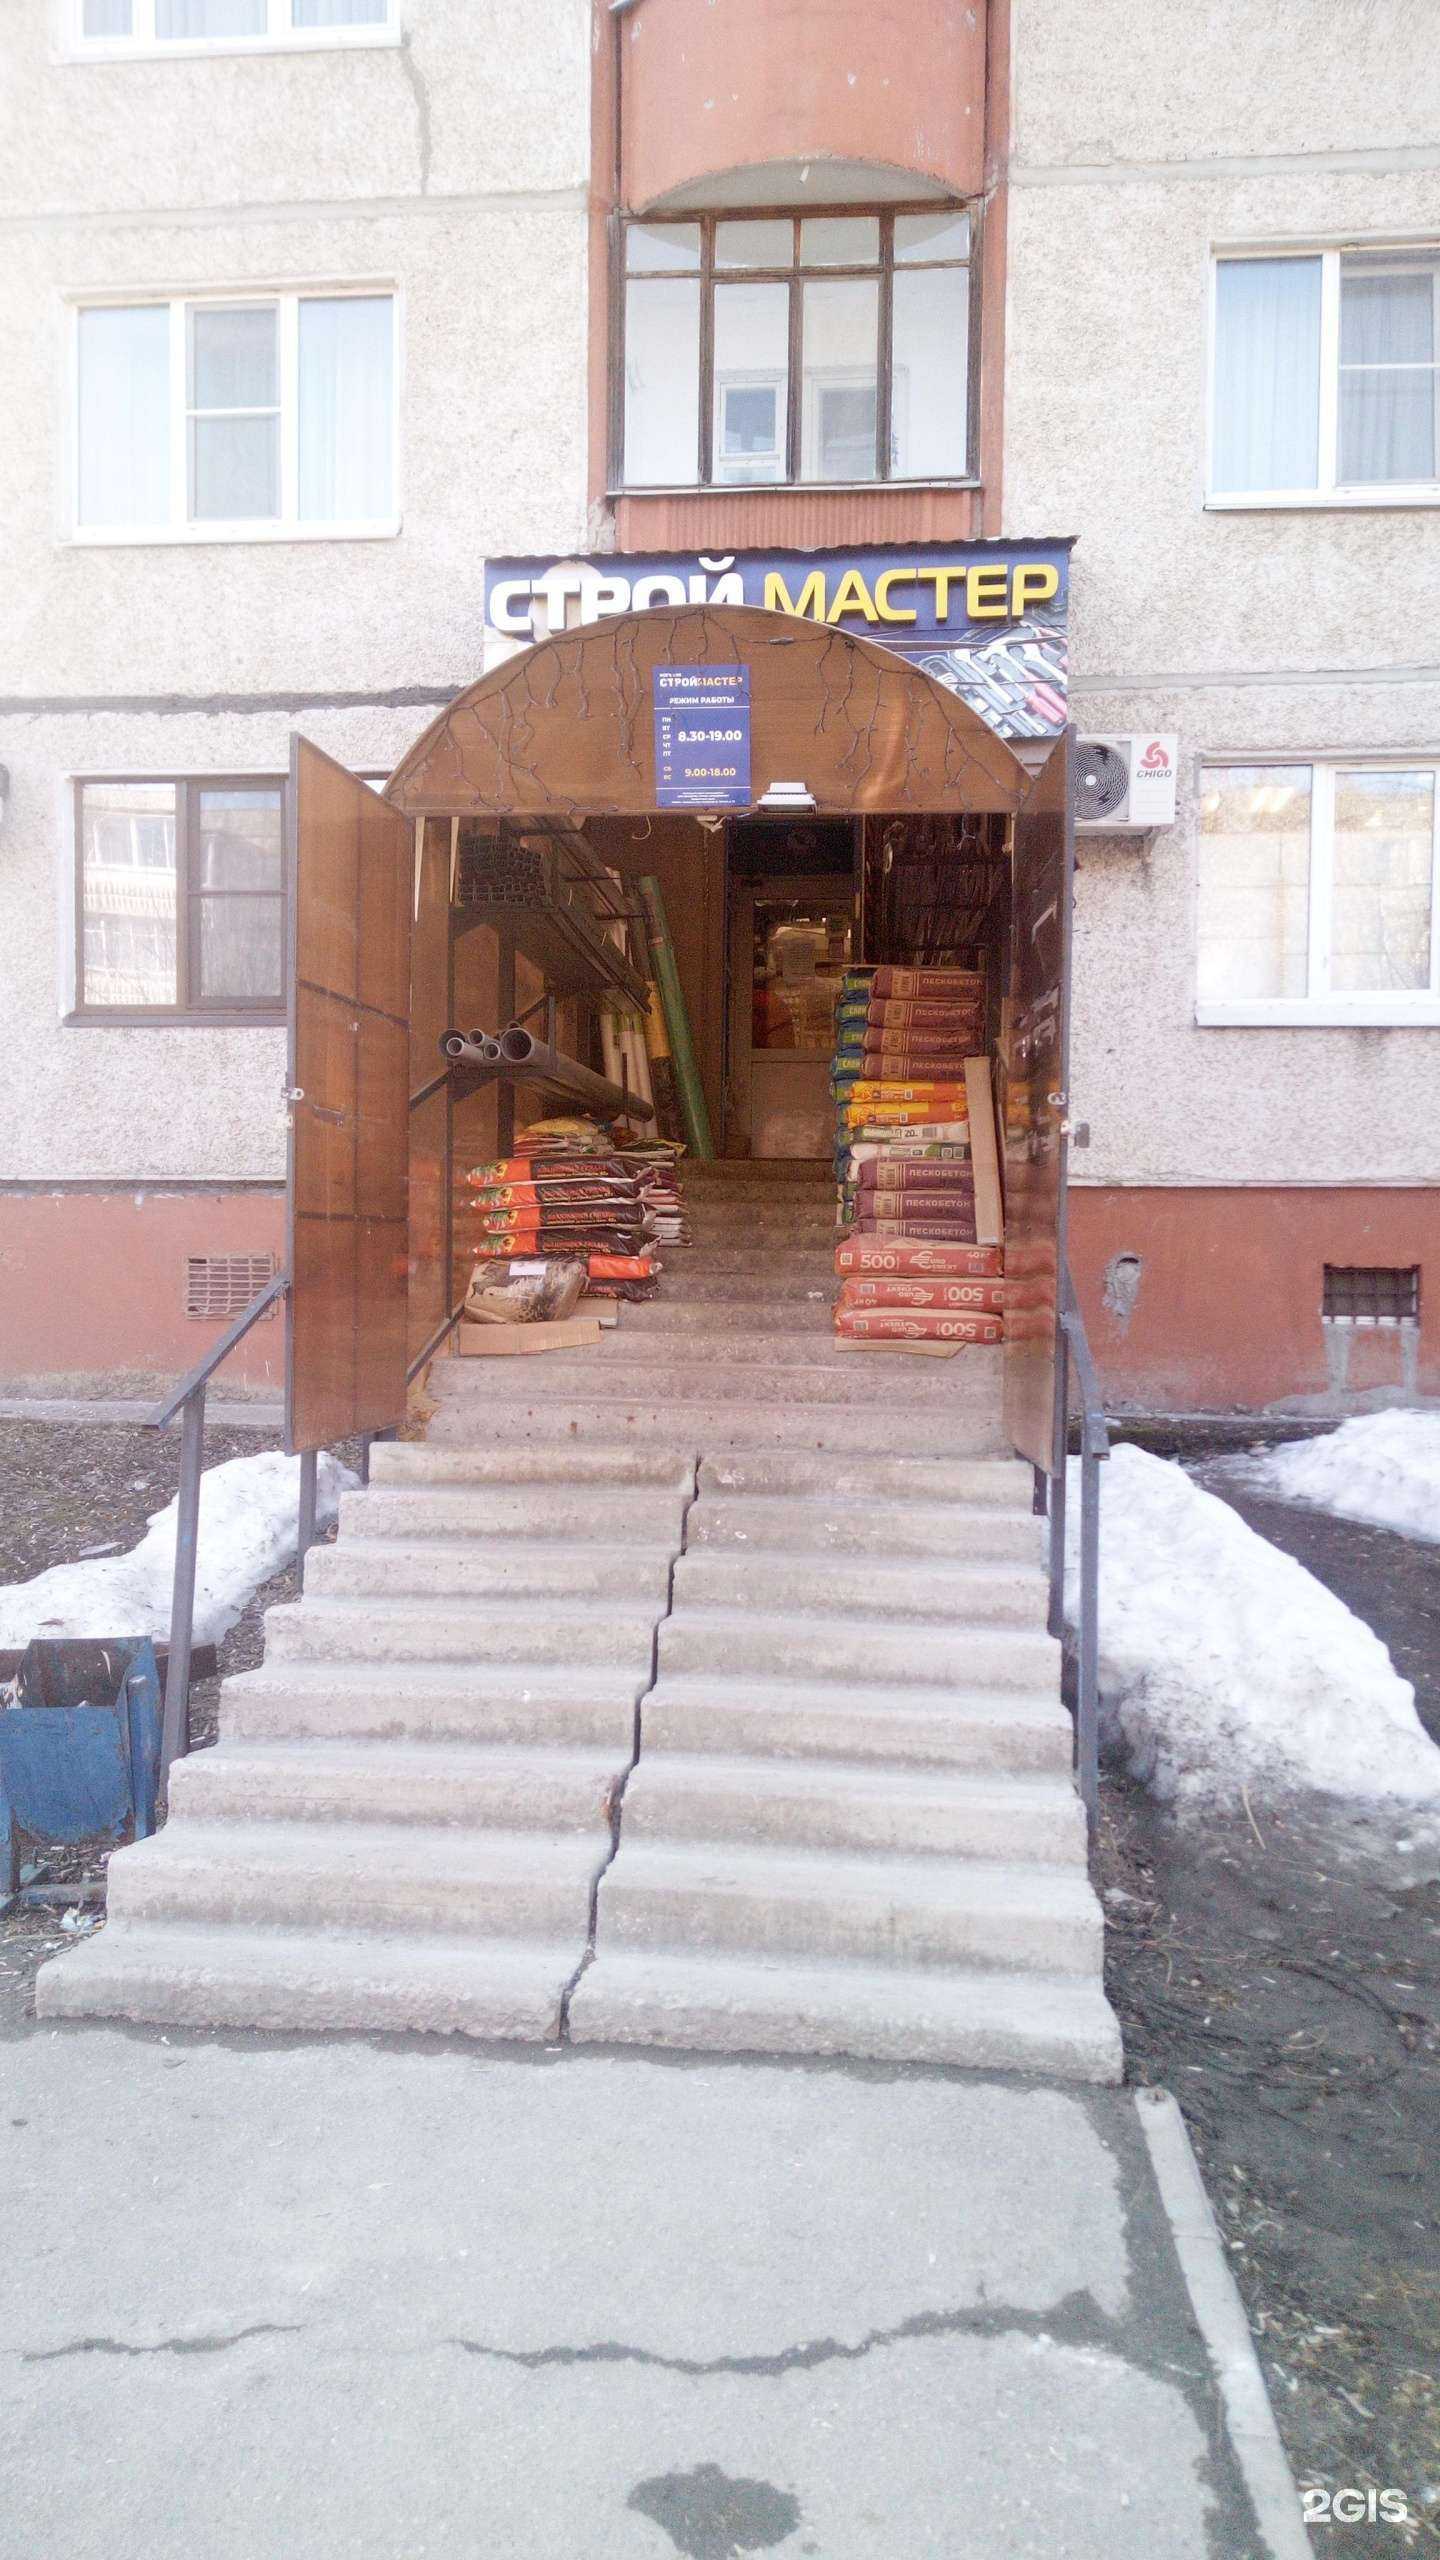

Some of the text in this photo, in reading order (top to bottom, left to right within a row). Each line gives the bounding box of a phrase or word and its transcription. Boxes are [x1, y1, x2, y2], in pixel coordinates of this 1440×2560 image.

[490, 556, 1060, 631] СТРОЙ МАСТЕР
[701, 696, 735, 704] РАБОТЫ
[678, 730, 742, 742] 8.30-19.00
[684, 768, 736, 777] 9.00-18.00
[1136, 769, 1172, 778] CHIGO
[860, 1255, 896, 1269] 500
[948, 1287, 984, 1302] 500
[941, 1322, 977, 1336] 500
